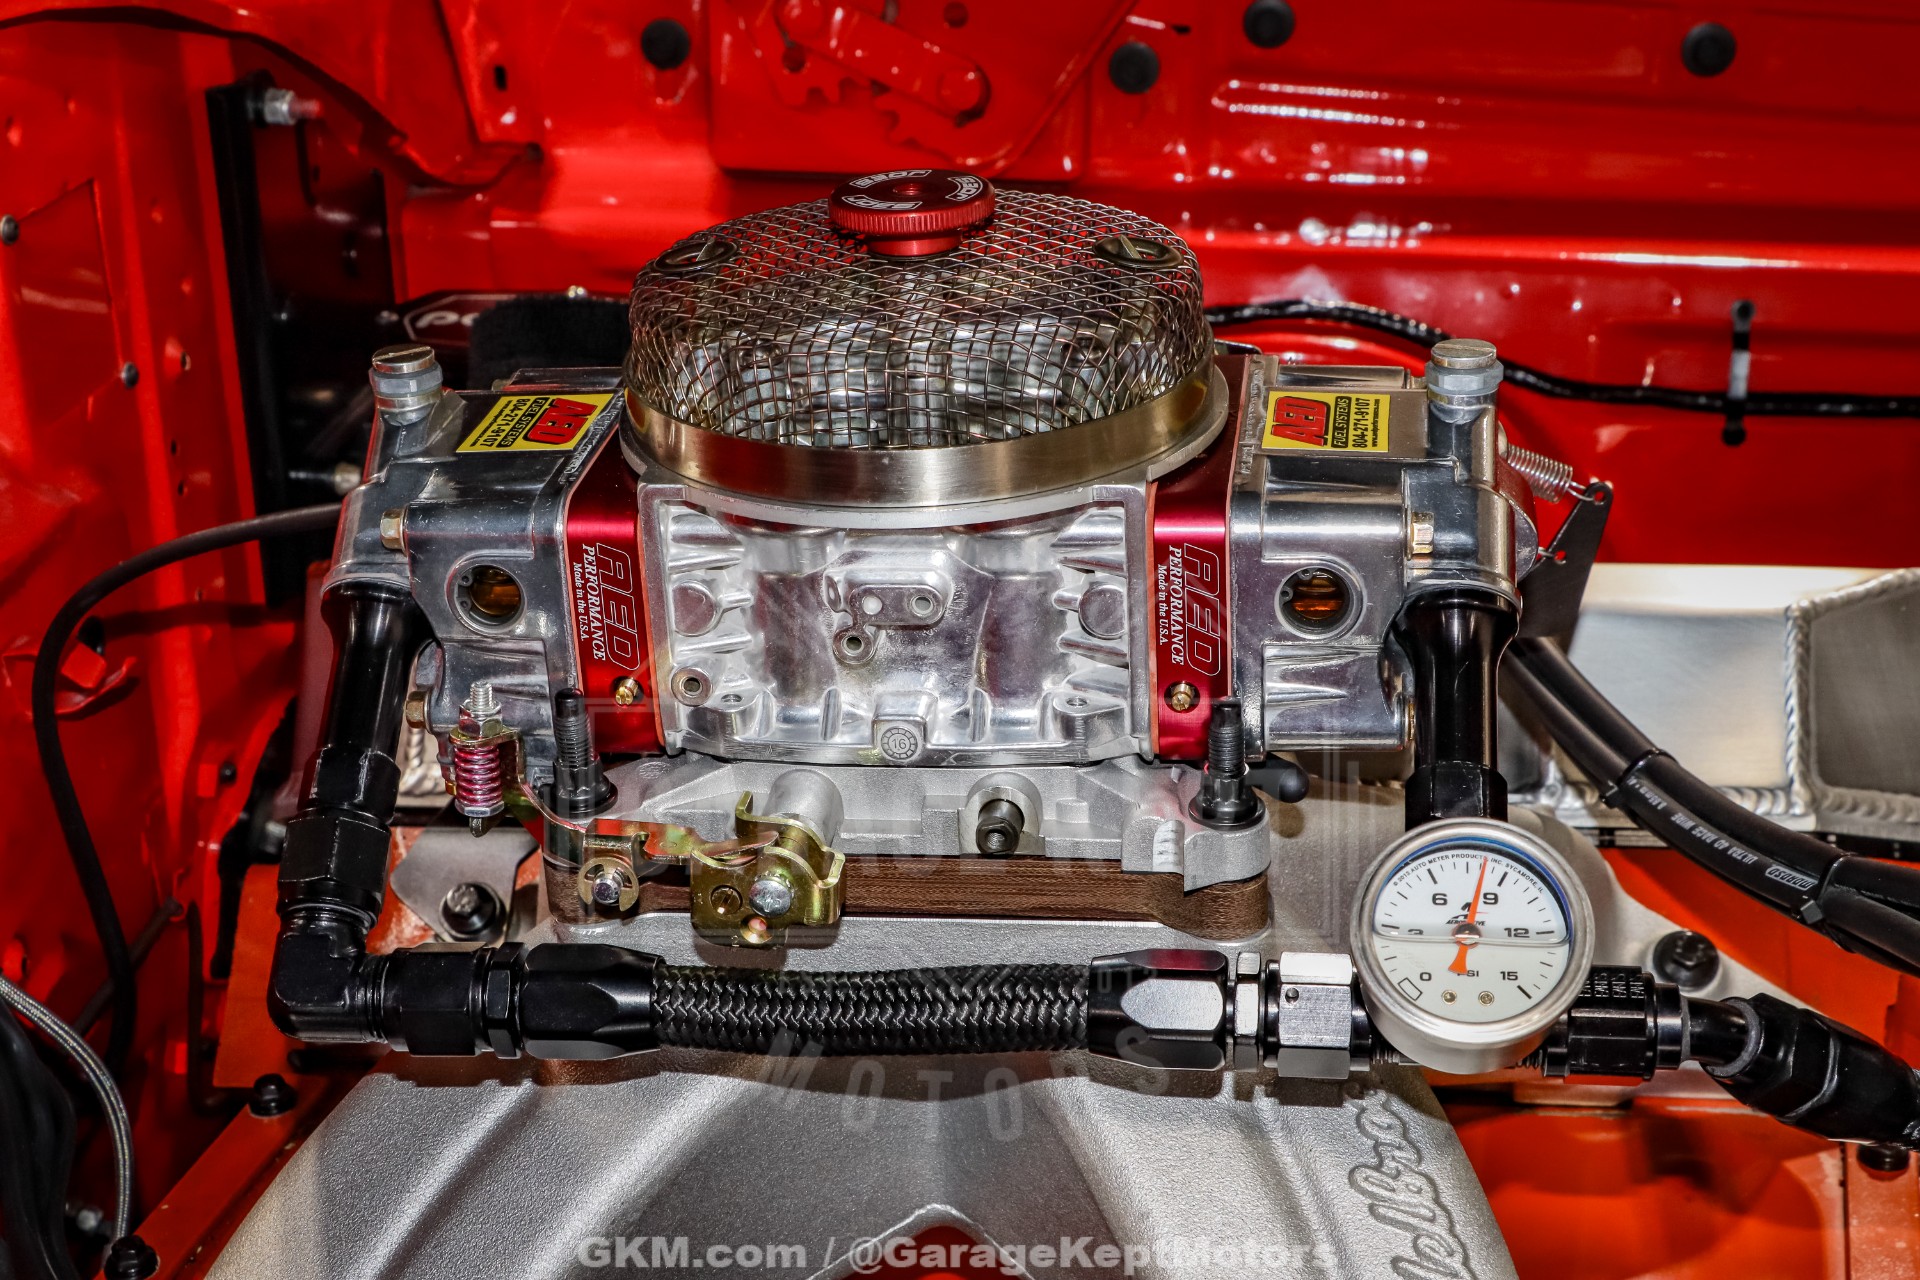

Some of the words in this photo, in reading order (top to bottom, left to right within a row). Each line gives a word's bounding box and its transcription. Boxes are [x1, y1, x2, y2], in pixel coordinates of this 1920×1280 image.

[954, 177, 980, 200] JOES
[522, 398, 546, 416] FUEL
[1335, 398, 1349, 427] SYSTEMS
[501, 416, 532, 446] SYSTEMS
[523, 397, 598, 446] AED
[1271, 396, 1331, 447] AED
[1352, 397, 1371, 448] 804-271-9107
[1333, 427, 1346, 447] FUEL
[573, 562, 585, 588] Made
[1158, 564, 1169, 590] Made
[576, 590, 584, 599] in
[582, 543, 606, 661] PERFORMANCE
[1158, 593, 1166, 601] in
[577, 599, 588, 614] the
[1159, 603, 1168, 617] the
[1169, 545, 1185, 666] PERFORMANCE
[1670, 812, 1697, 831] WIRE
[1691, 825, 1715, 844] RACE
[1713, 839, 1730, 851] 40
[1727, 846, 1758, 865] ULTRA
[1410, 861, 1427, 873] AUTO
[1427, 854, 1450, 864] METER
[1504, 862, 1539, 889] SYCAMORE,
[1767, 866, 1817, 890] MOROSO
[1432, 892, 1448, 906] 6
[1482, 892, 1499, 905] 9
[1504, 927, 1530, 938] 12
[1419, 971, 1432, 982] 0
[1500, 971, 1519, 981] 15
